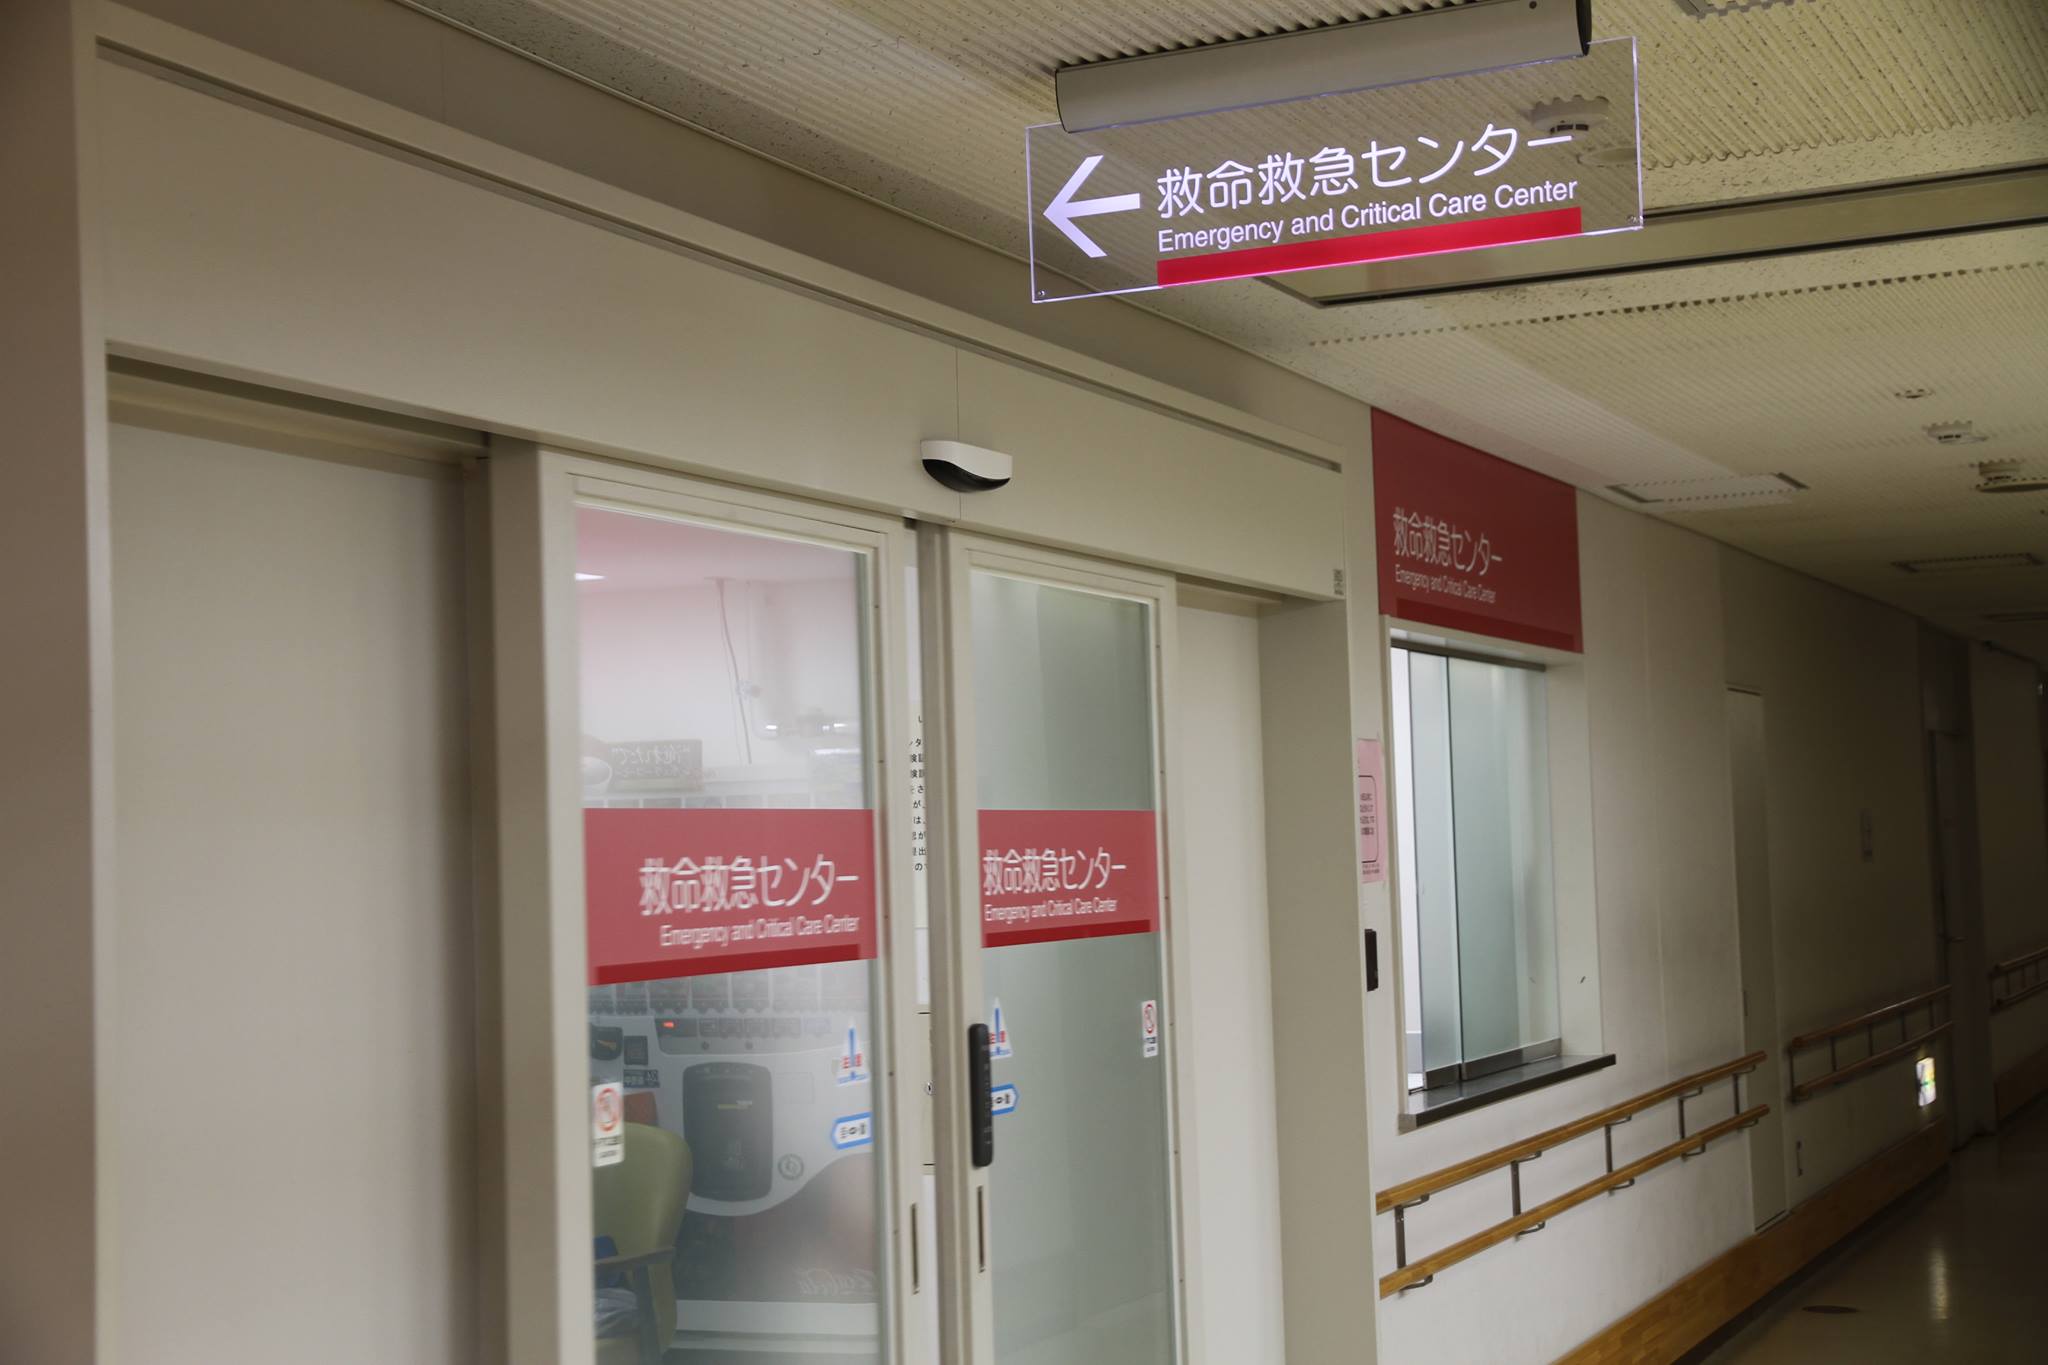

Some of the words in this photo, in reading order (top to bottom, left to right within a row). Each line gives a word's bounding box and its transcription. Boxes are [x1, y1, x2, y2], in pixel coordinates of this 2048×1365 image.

[1157, 122, 1573, 218] 救命救急センター
[1158, 219, 1284, 252] Emergency
[1291, 208, 1333, 236] and
[1341, 197, 1421, 228] Critical
[1428, 192, 1487, 217] Care
[1494, 180, 1578, 209] Center
[1393, 507, 1503, 576] 救命救急センター
[1395, 563, 1429, 593] Emergency
[1431, 575, 1441, 592] and
[1463, 580, 1476, 599] Care
[1478, 583, 1496, 603] Center
[639, 852, 859, 917] 救命救急センター
[983, 847, 1126, 895] 救命救急センター
[660, 924, 729, 949] Emergency
[731, 920, 754, 941] and
[756, 917, 794, 938] Critical
[796, 916, 822, 935] Care
[824, 913, 859, 933] Center
[984, 904, 1030, 924] Emergency
[1031, 901, 1047, 917] and
[1048, 899, 1073, 916] Critical
[1075, 898, 1092, 914] Care
[1093, 896, 1117, 912] Center
